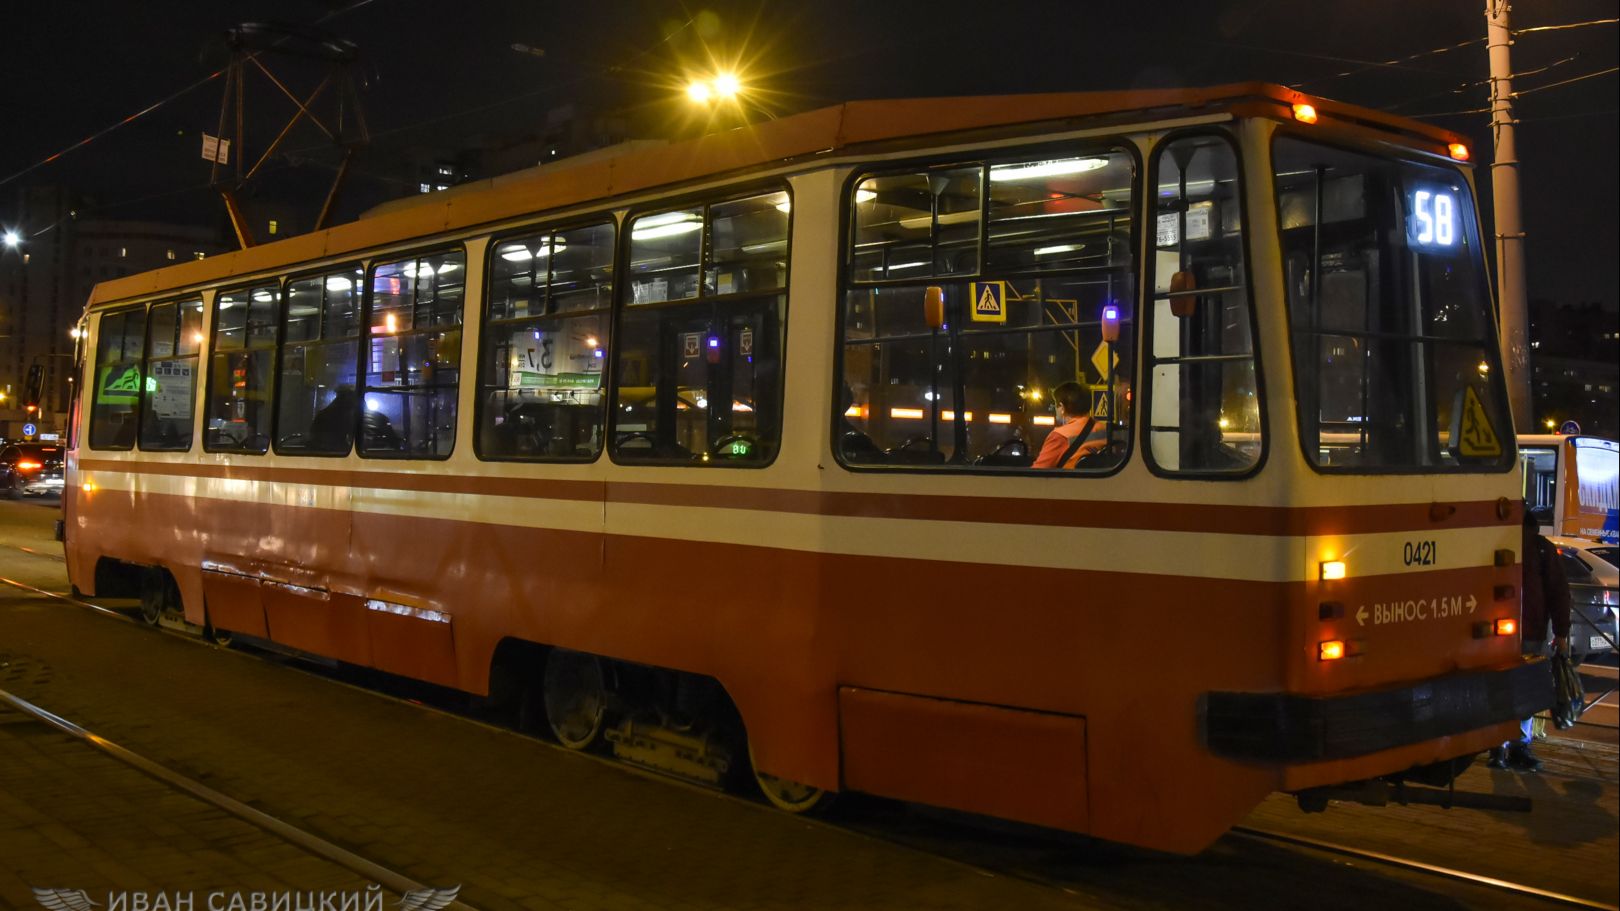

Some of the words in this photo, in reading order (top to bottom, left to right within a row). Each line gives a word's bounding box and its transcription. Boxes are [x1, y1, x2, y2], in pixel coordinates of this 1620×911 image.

[1415, 190, 1453, 246] 58
[1404, 541, 1436, 566] 0421
[1374, 600, 1427, 625] ВЫНОС
[1430, 597, 1449, 618] 1.5
[1451, 595, 1462, 616] М
